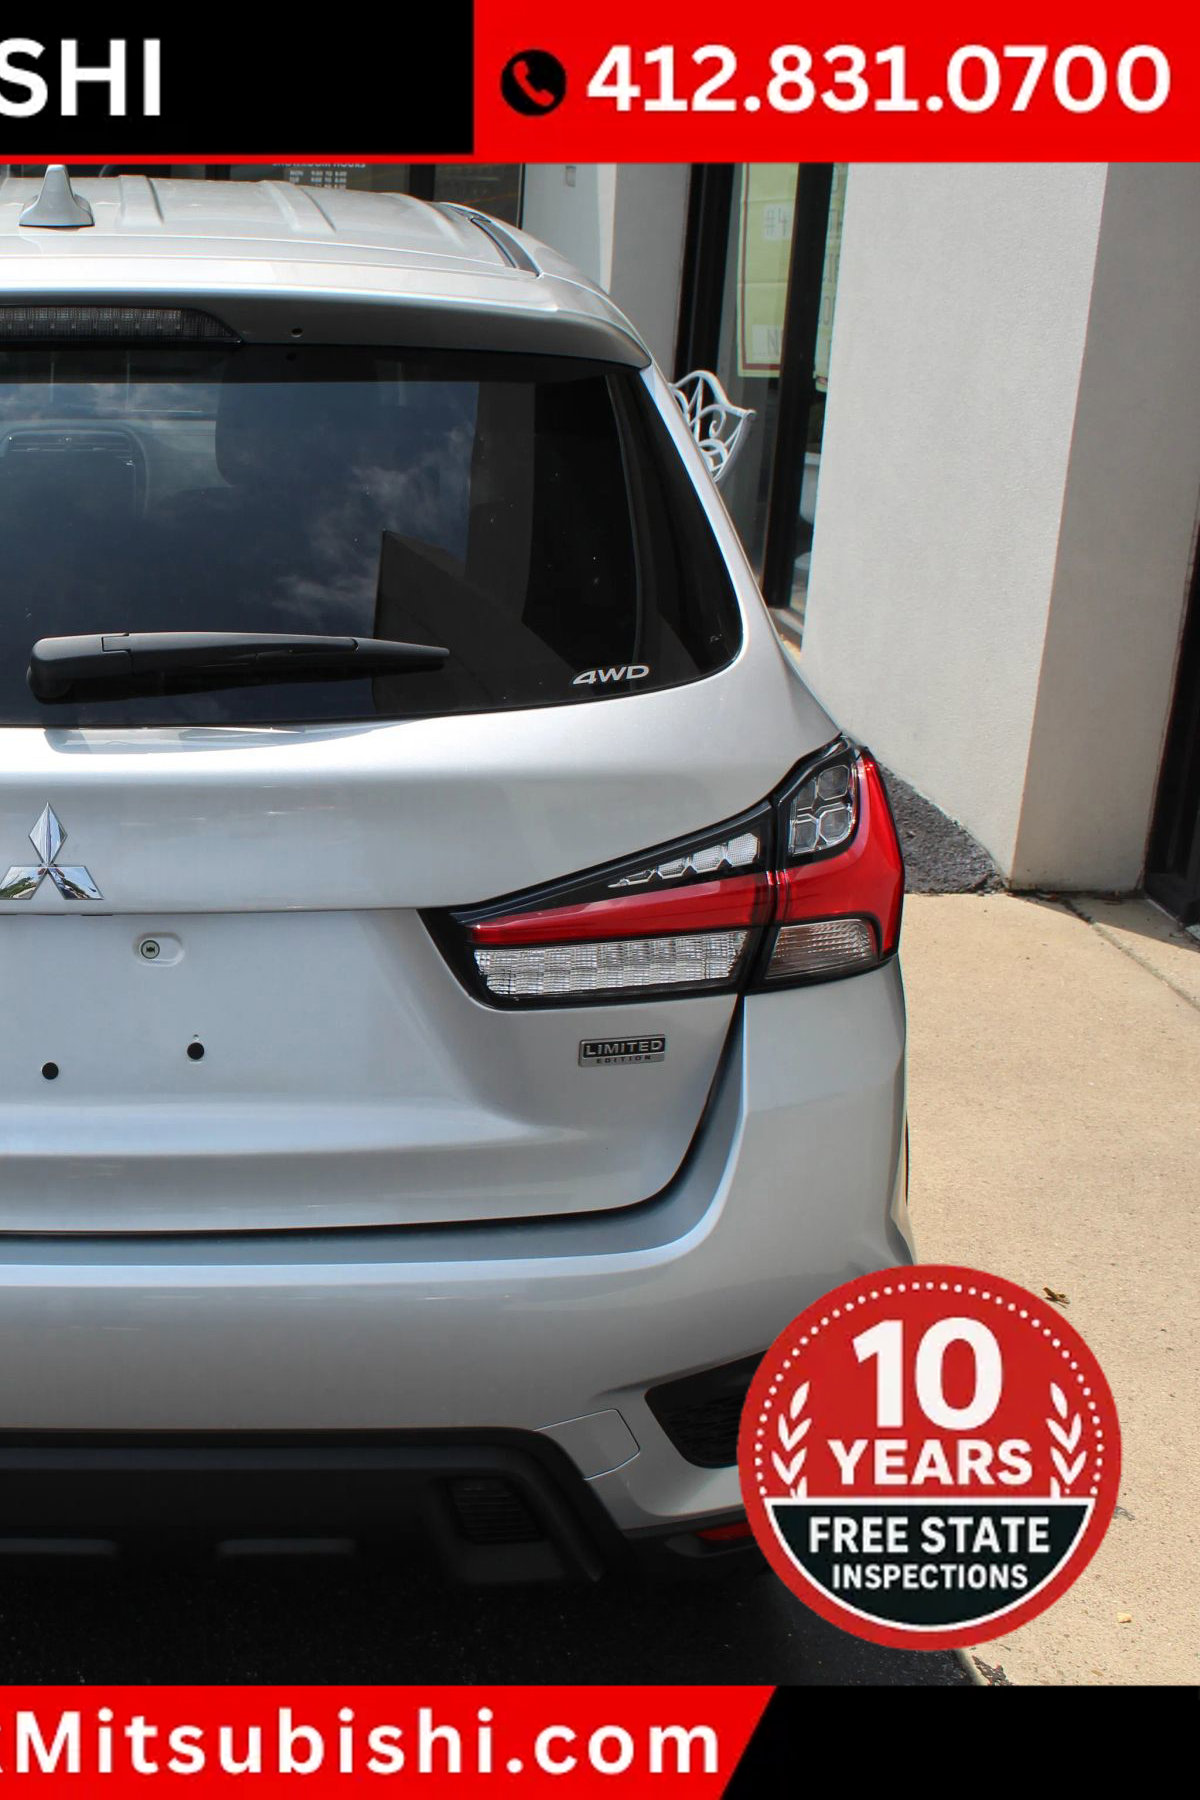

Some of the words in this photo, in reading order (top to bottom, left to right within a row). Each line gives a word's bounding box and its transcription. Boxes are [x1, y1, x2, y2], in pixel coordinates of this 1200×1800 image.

[572, 664, 650, 685] 4WD
[585, 1040, 663, 1056] LIMITED
[596, 1054, 652, 1064] EDITION
